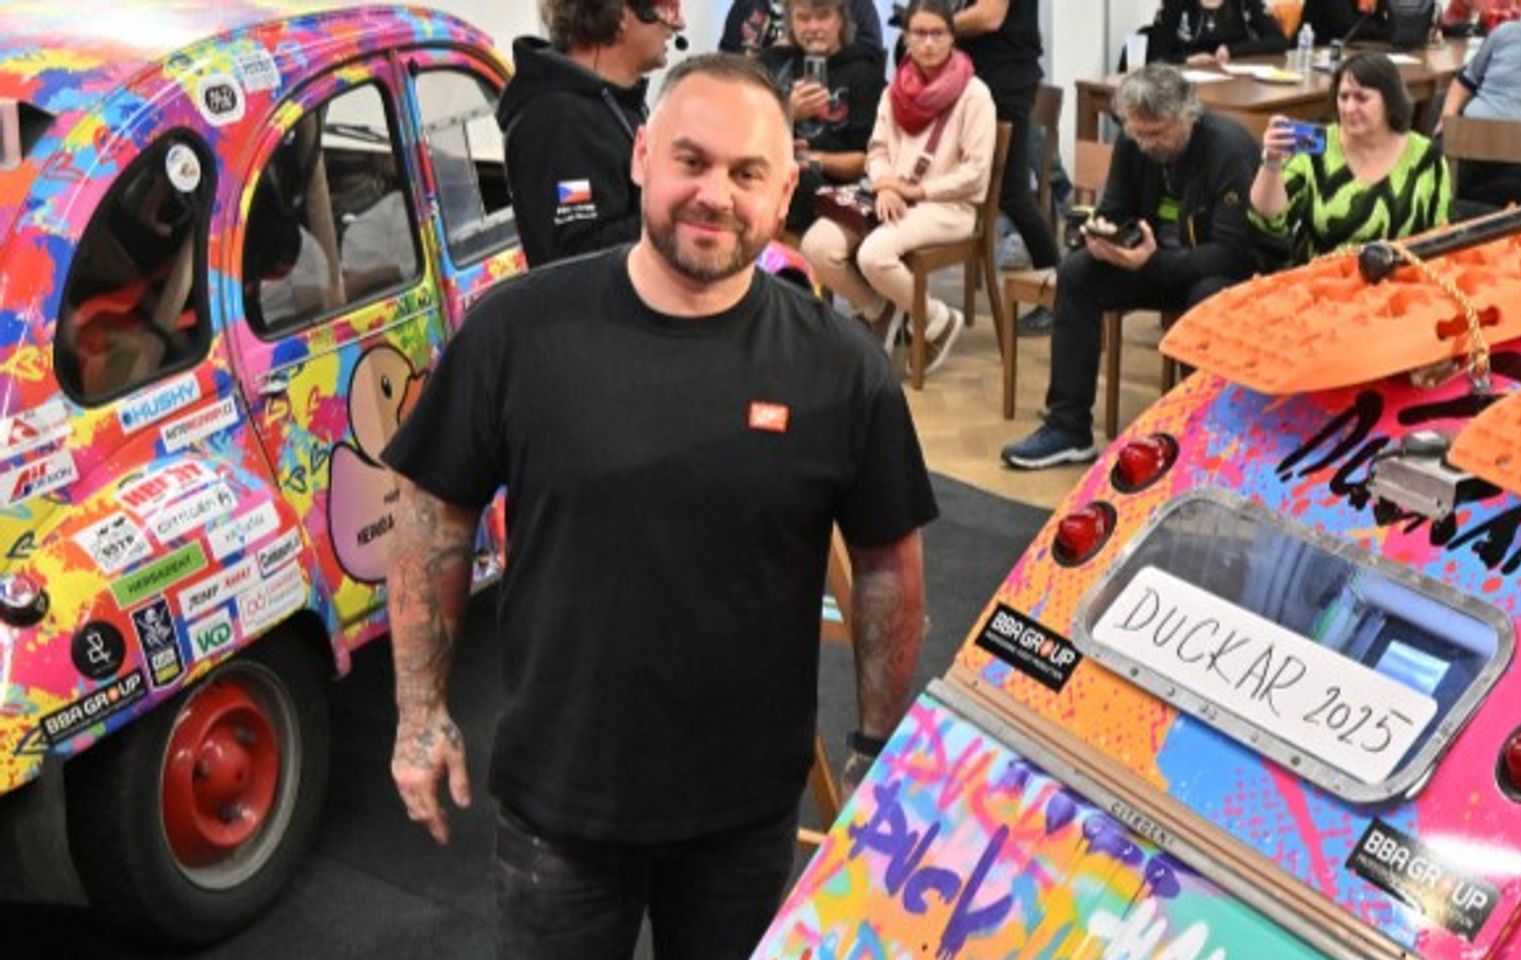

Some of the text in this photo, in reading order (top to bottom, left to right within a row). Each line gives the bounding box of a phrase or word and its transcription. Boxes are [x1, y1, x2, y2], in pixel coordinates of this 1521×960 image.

[990, 610, 1023, 642] BBA
[1113, 586, 1308, 717] DUCKAR
[1302, 685, 1415, 752] 2025
[45, 706, 83, 735] BBA
[1363, 830, 1409, 872] BBA
